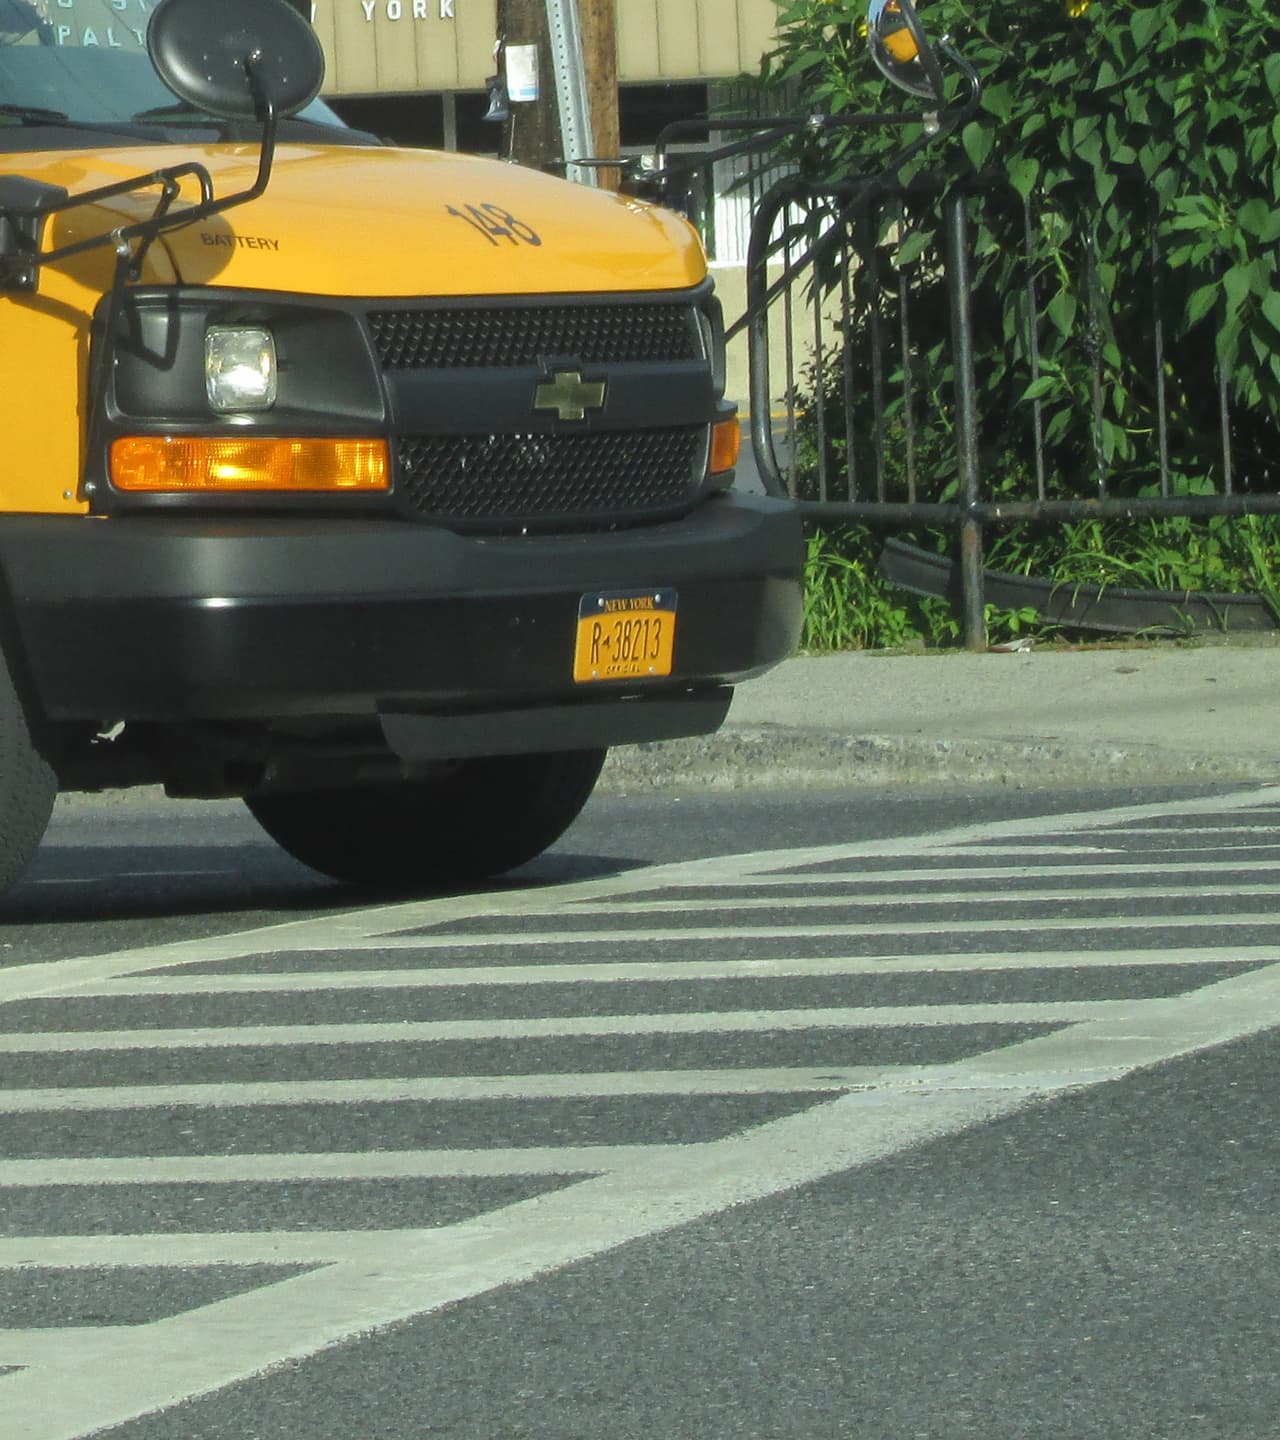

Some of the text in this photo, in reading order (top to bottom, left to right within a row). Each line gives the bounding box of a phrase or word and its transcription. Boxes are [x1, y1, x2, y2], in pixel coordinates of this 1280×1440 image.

[445, 203, 542, 247] 148
[201, 233, 279, 251] BATTERY
[605, 596, 655, 612] NEW YORK
